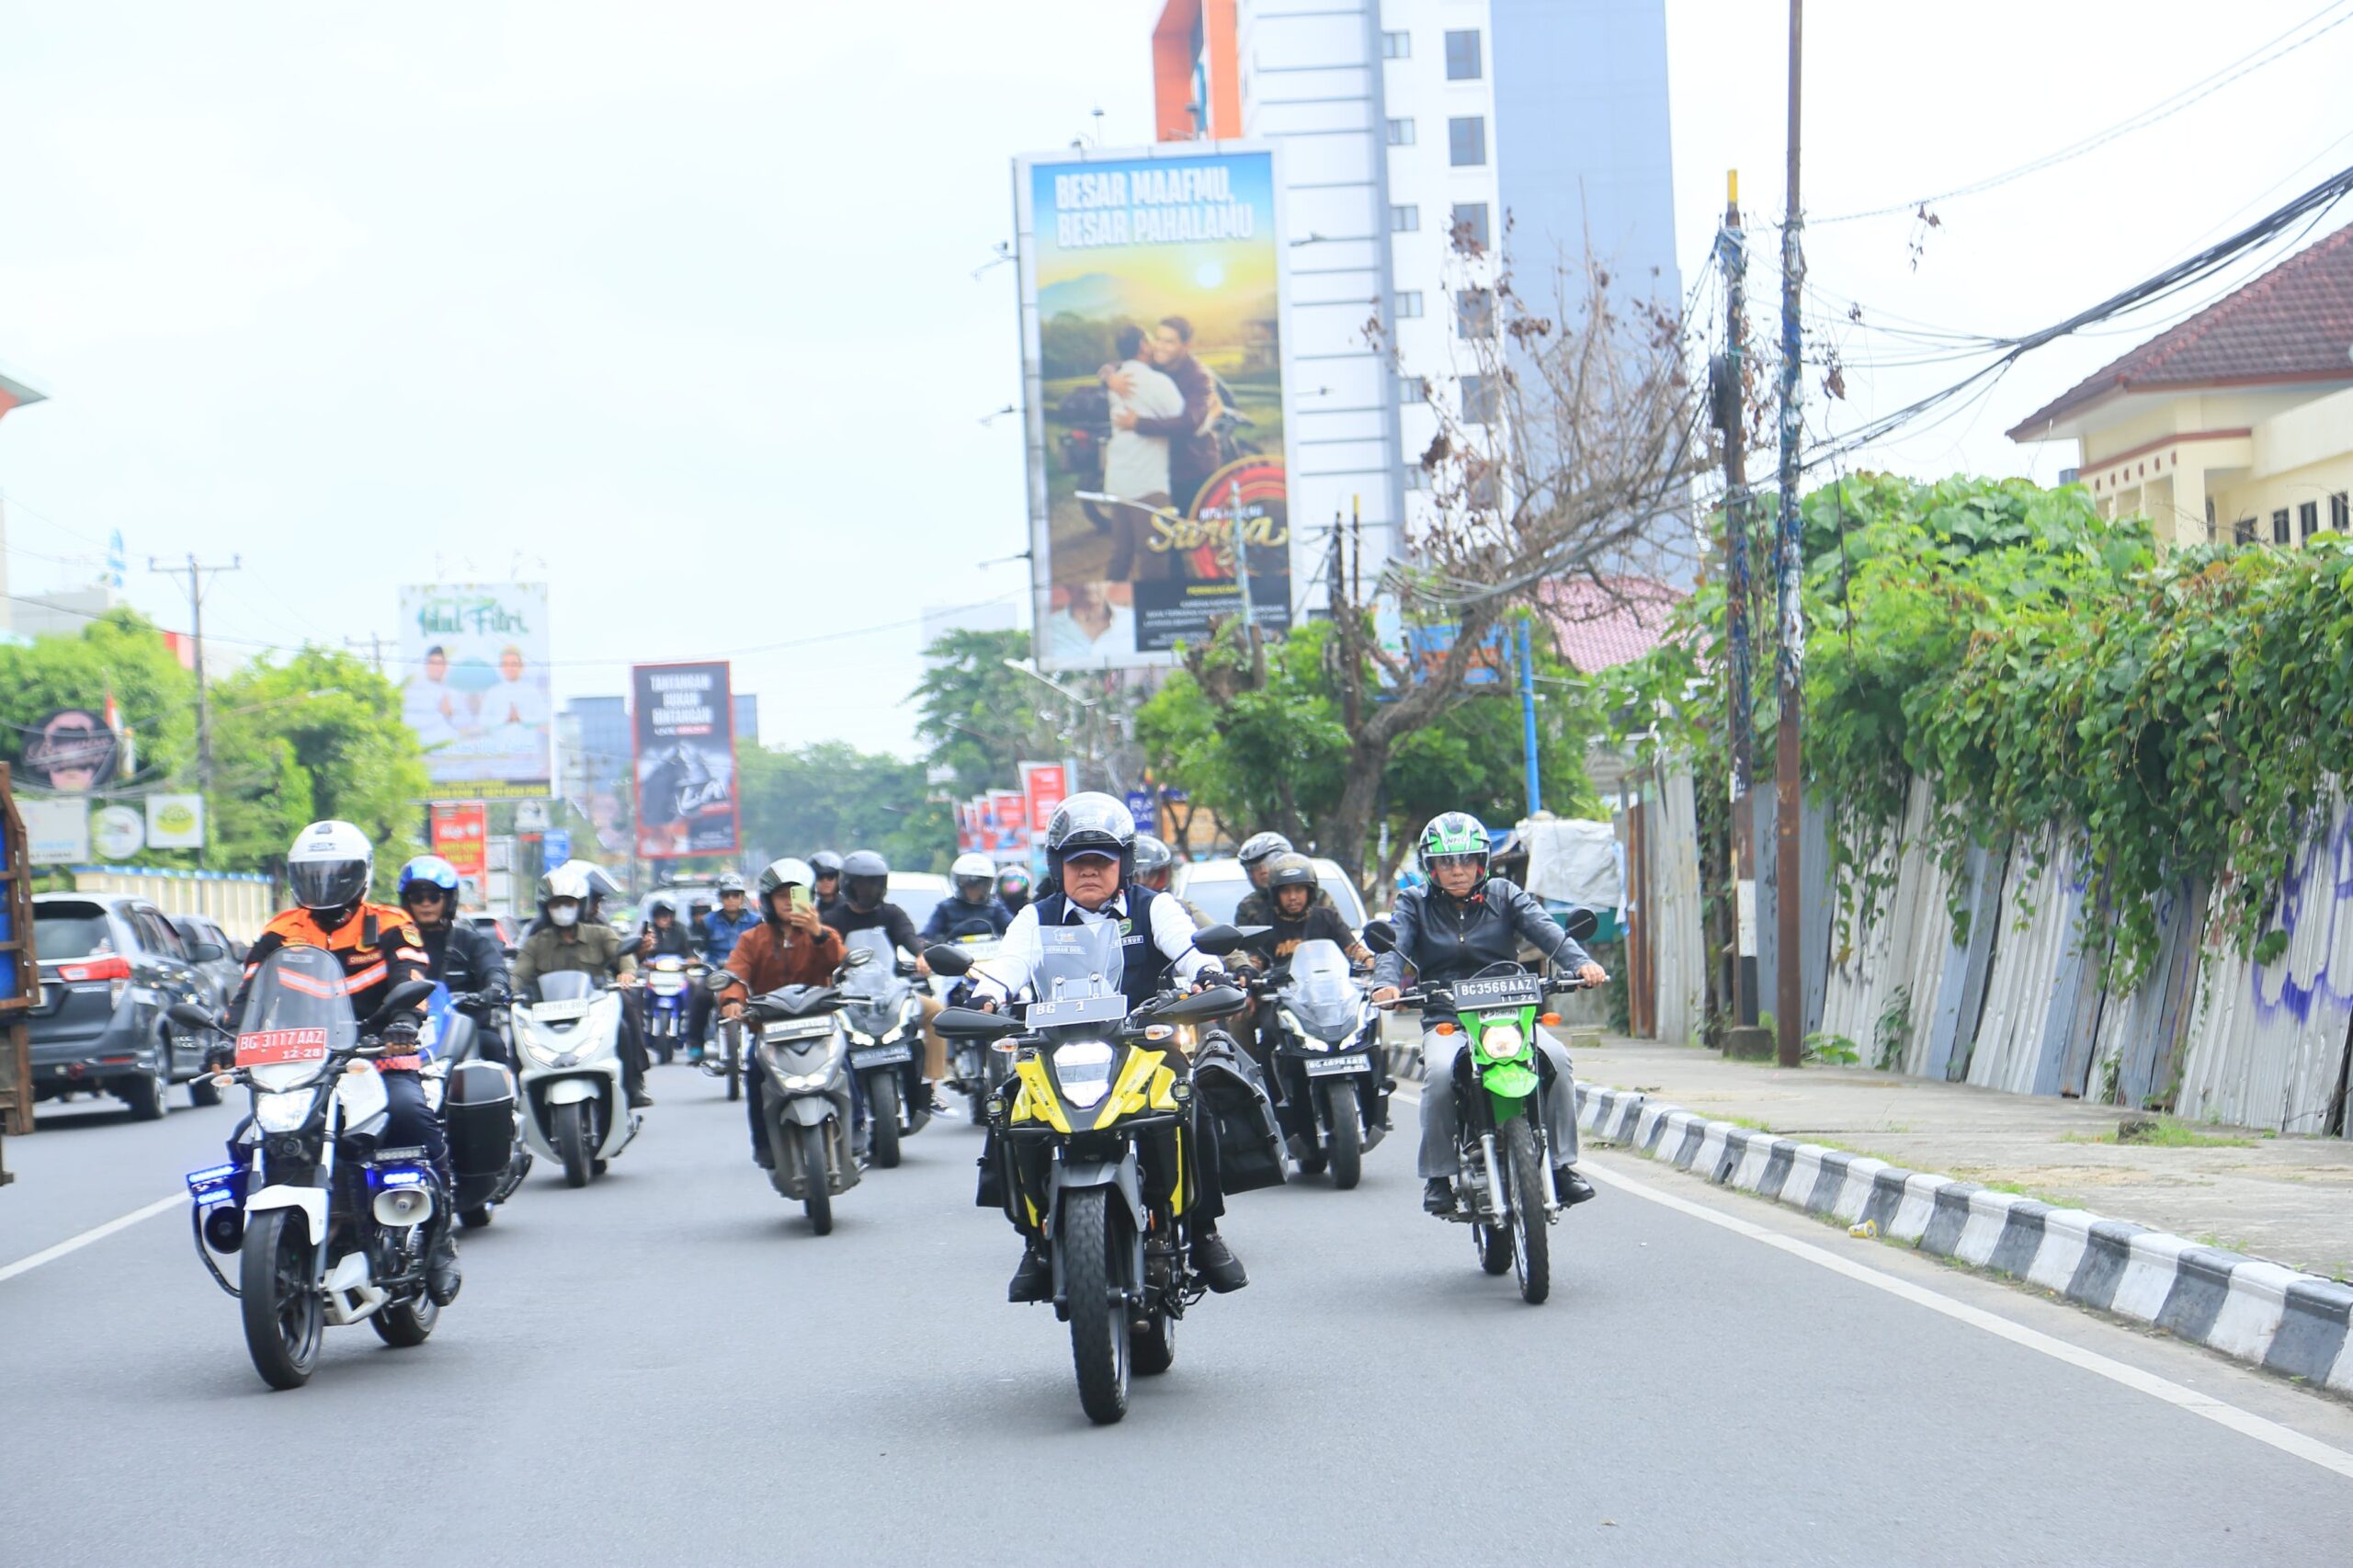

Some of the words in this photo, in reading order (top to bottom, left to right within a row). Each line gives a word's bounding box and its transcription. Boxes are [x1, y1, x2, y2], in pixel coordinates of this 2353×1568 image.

[1055, 172, 1127, 210] BESAR
[1130, 165, 1235, 204] MAAFMU,
[1056, 210, 1129, 248] BESAR
[1132, 203, 1253, 243] PAHALAMU
[651, 673, 712, 692] TANTANGAN
[652, 706, 713, 725] RINTANGAN
[1036, 1004, 1055, 1016] BG
[1075, 1000, 1084, 1012] 1
[240, 1036, 257, 1051] BG
[282, 1048, 320, 1059] 12-28
